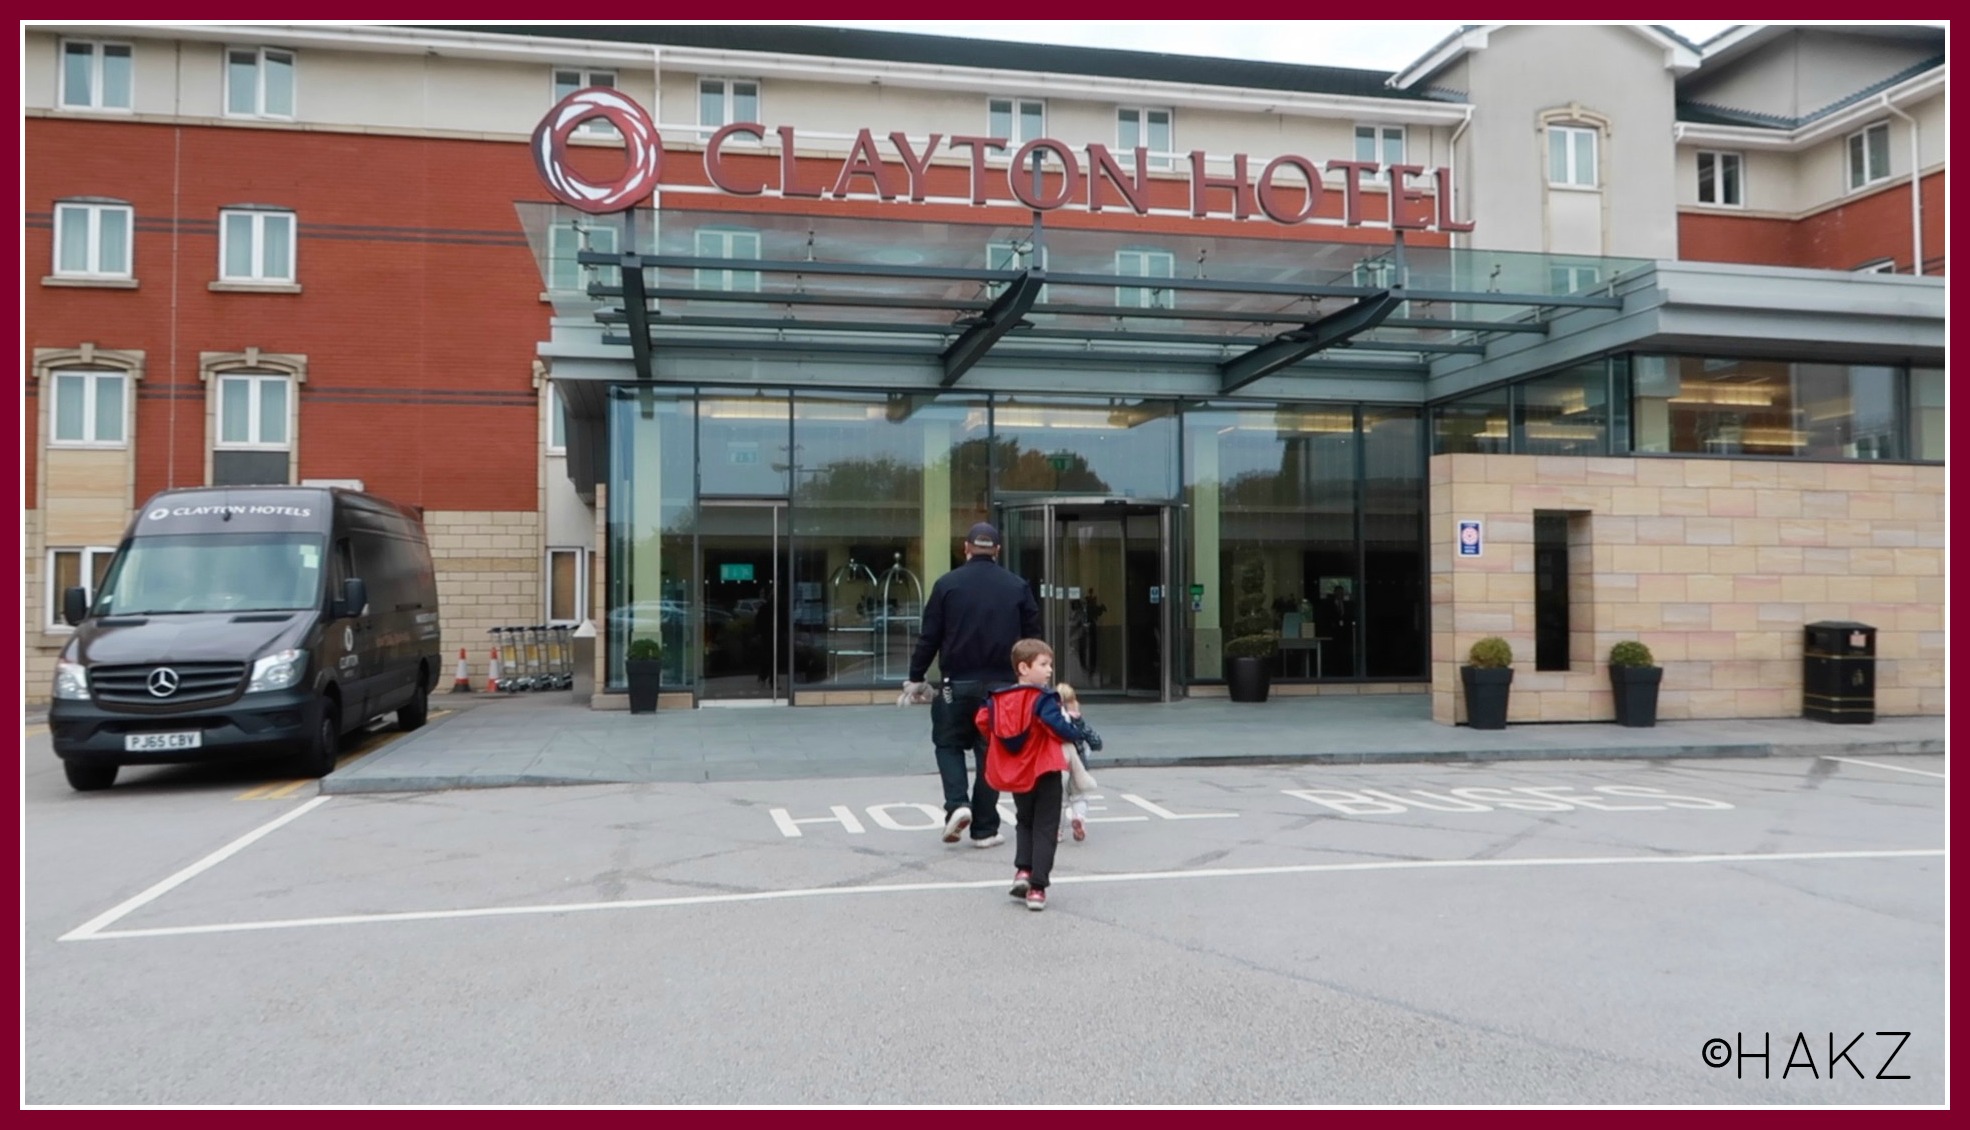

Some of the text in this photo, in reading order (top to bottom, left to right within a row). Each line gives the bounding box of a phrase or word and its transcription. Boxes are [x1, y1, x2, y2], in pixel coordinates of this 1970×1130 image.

[703, 121, 1476, 233] CLAYTON HOTEL
[172, 505, 312, 517] CLAYTON HOTELS
[131, 734, 195, 749] PJ65 CBV
[1280, 786, 1735, 815] BUSES
